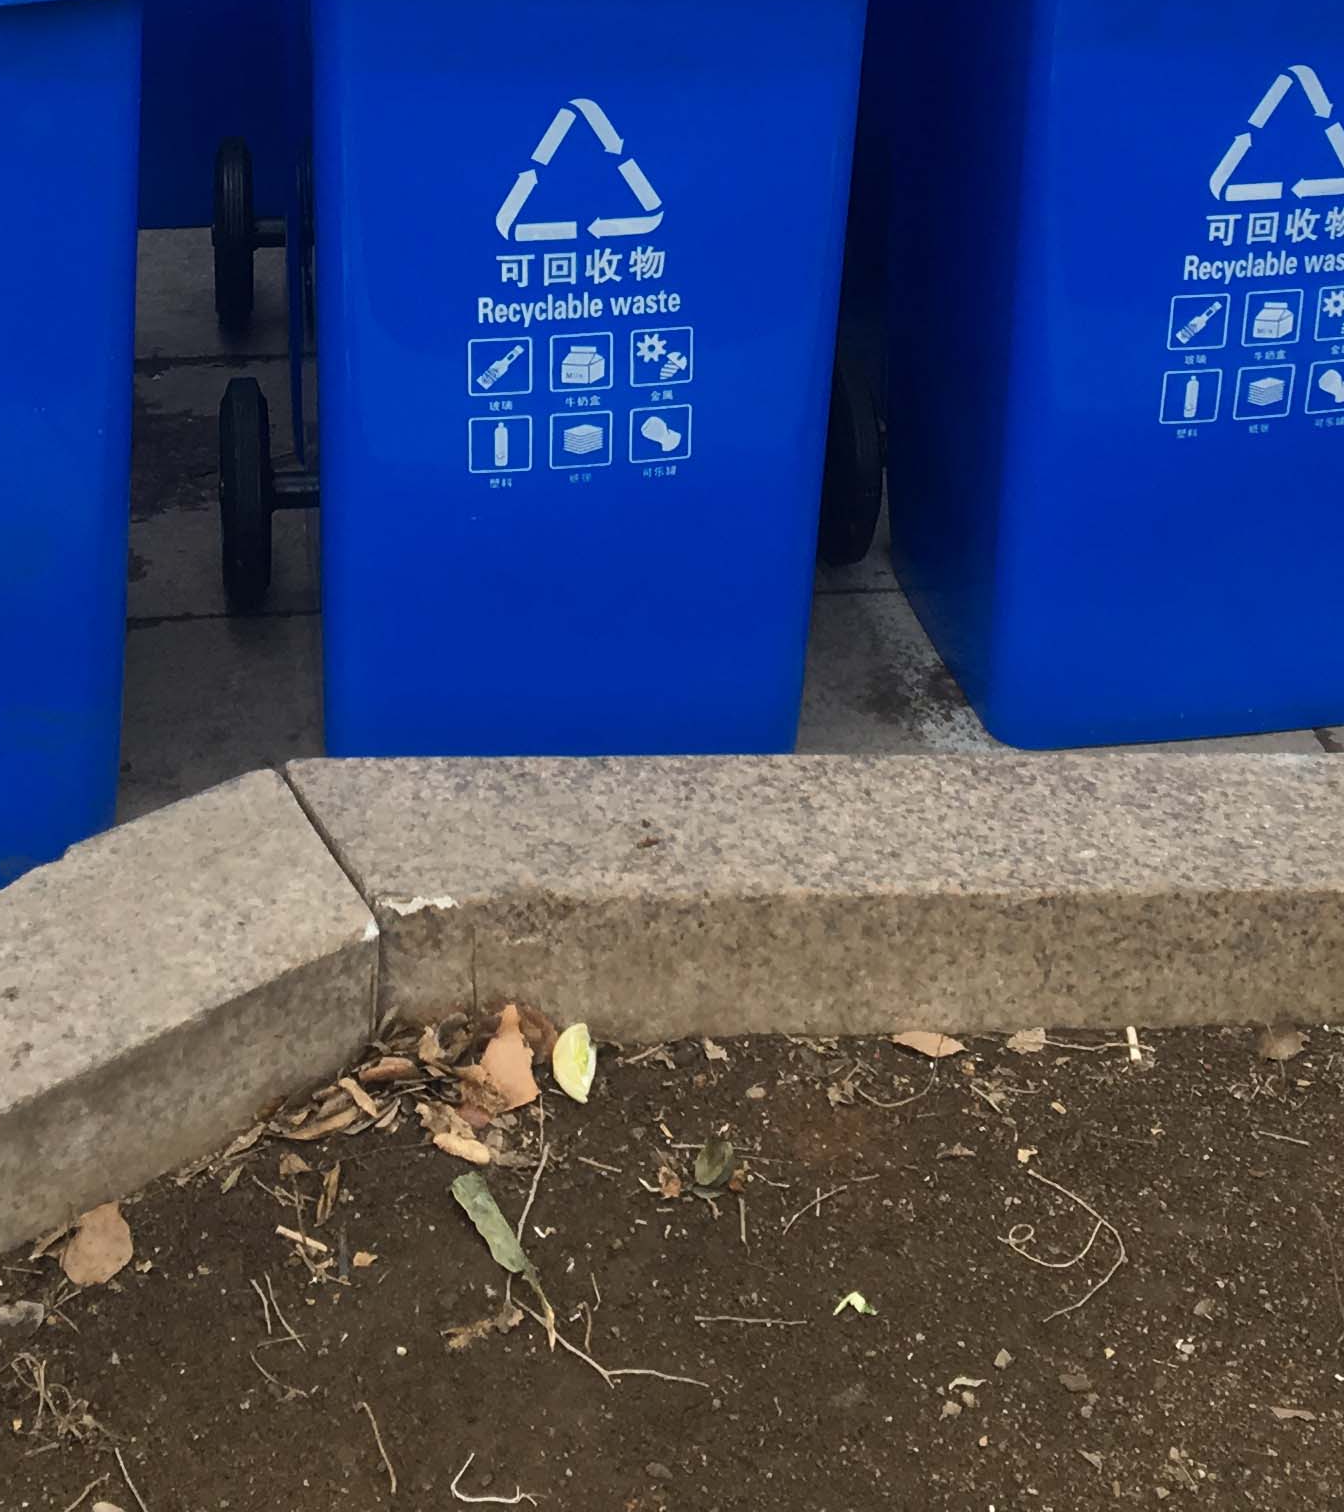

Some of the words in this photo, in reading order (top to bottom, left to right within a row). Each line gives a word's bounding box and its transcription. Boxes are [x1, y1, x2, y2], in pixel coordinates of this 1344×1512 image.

[496, 246, 666, 287] 可回收物
[1183, 250, 1297, 285] Recyclable
[478, 292, 603, 328] Recyclable
[610, 290, 681, 315] waste
